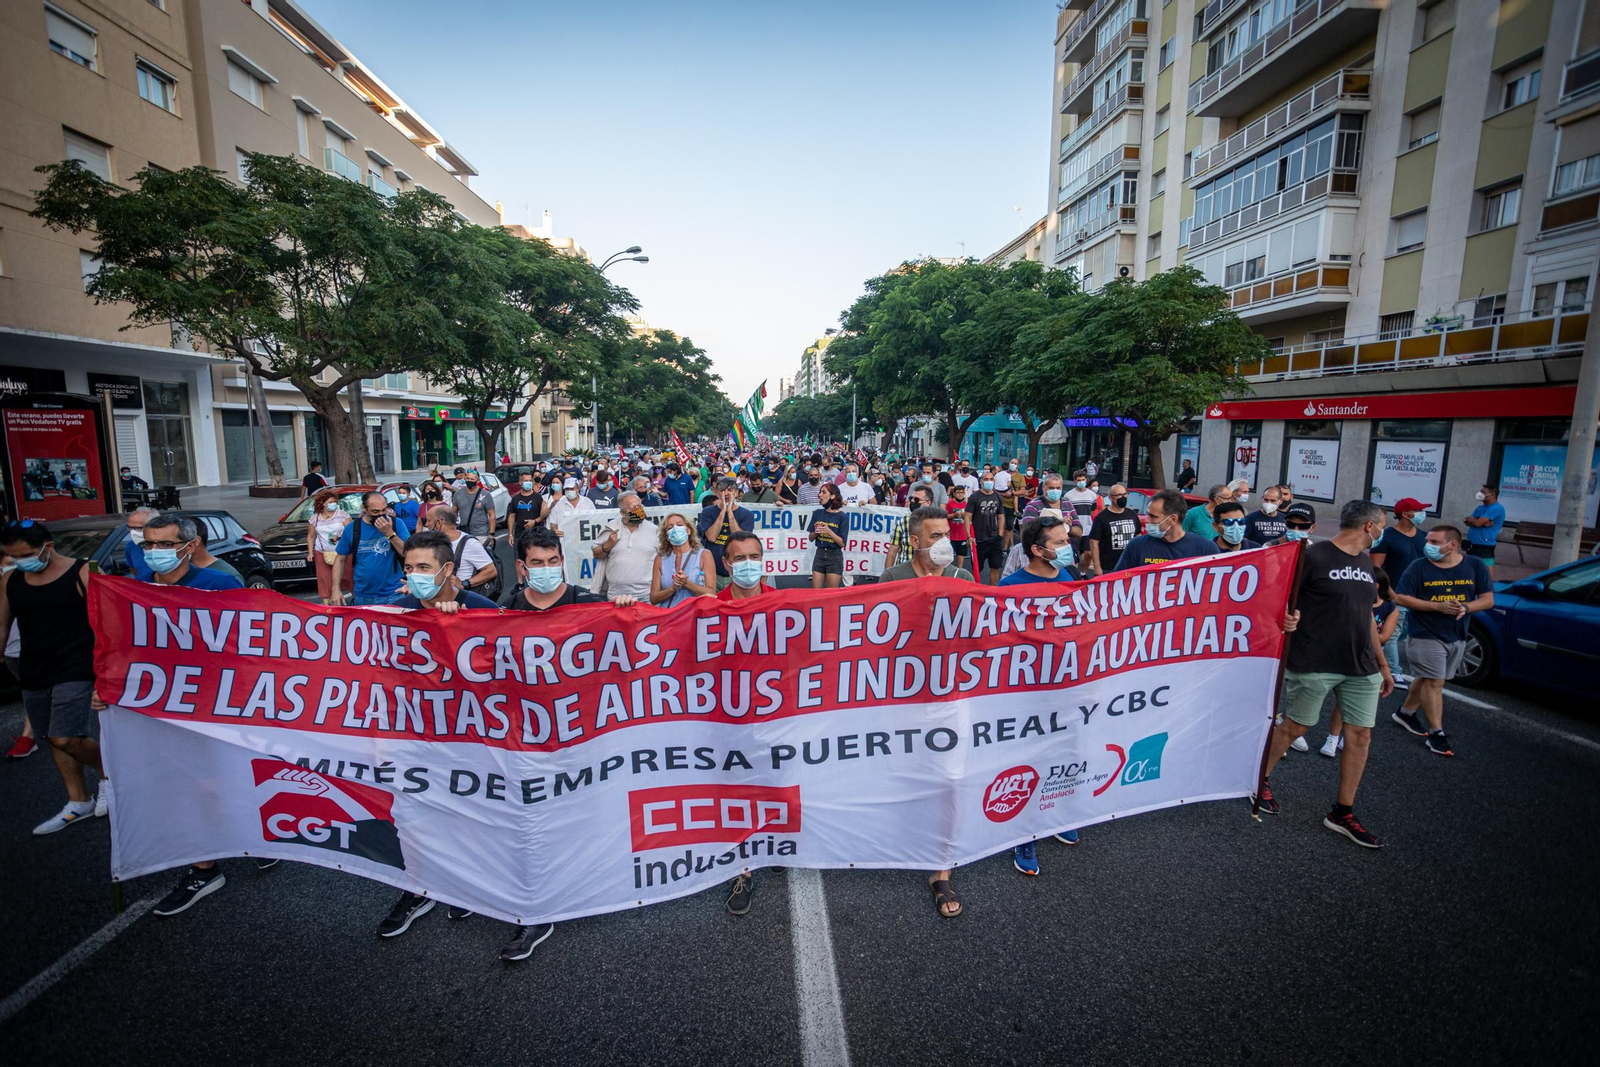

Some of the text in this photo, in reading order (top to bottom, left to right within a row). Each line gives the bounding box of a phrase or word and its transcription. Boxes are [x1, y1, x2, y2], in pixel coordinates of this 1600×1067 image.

[1317, 401, 1368, 416] Santander
[1236, 448, 1256, 463] ONE
[751, 510, 792, 529] PLEO
[580, 520, 601, 541] En
[787, 537, 807, 550] DE
[1329, 566, 1373, 583] adidas
[130, 564, 1260, 686] INVERSIONES, CARGAS, EMPLEO, MANTENIMIENTO
[118, 614, 1252, 744] DE LAS PLANTAS DE AIRBUS E INDUSTRIA AUXILIAR
[267, 686, 1170, 804] MITÉS DE EMPRESA PUERTO REAL Y CBC
[1046, 761, 1088, 780] FICA
[991, 771, 1036, 798] UGT
[1041, 779, 1086, 794] Construcción
[1092, 773, 1109, 784] Agro
[1039, 788, 1075, 802] Andalucía
[1039, 801, 1055, 811] Cádiz
[643, 798, 788, 836] CCOO
[266, 812, 358, 849] CGT
[633, 835, 797, 889] industria
